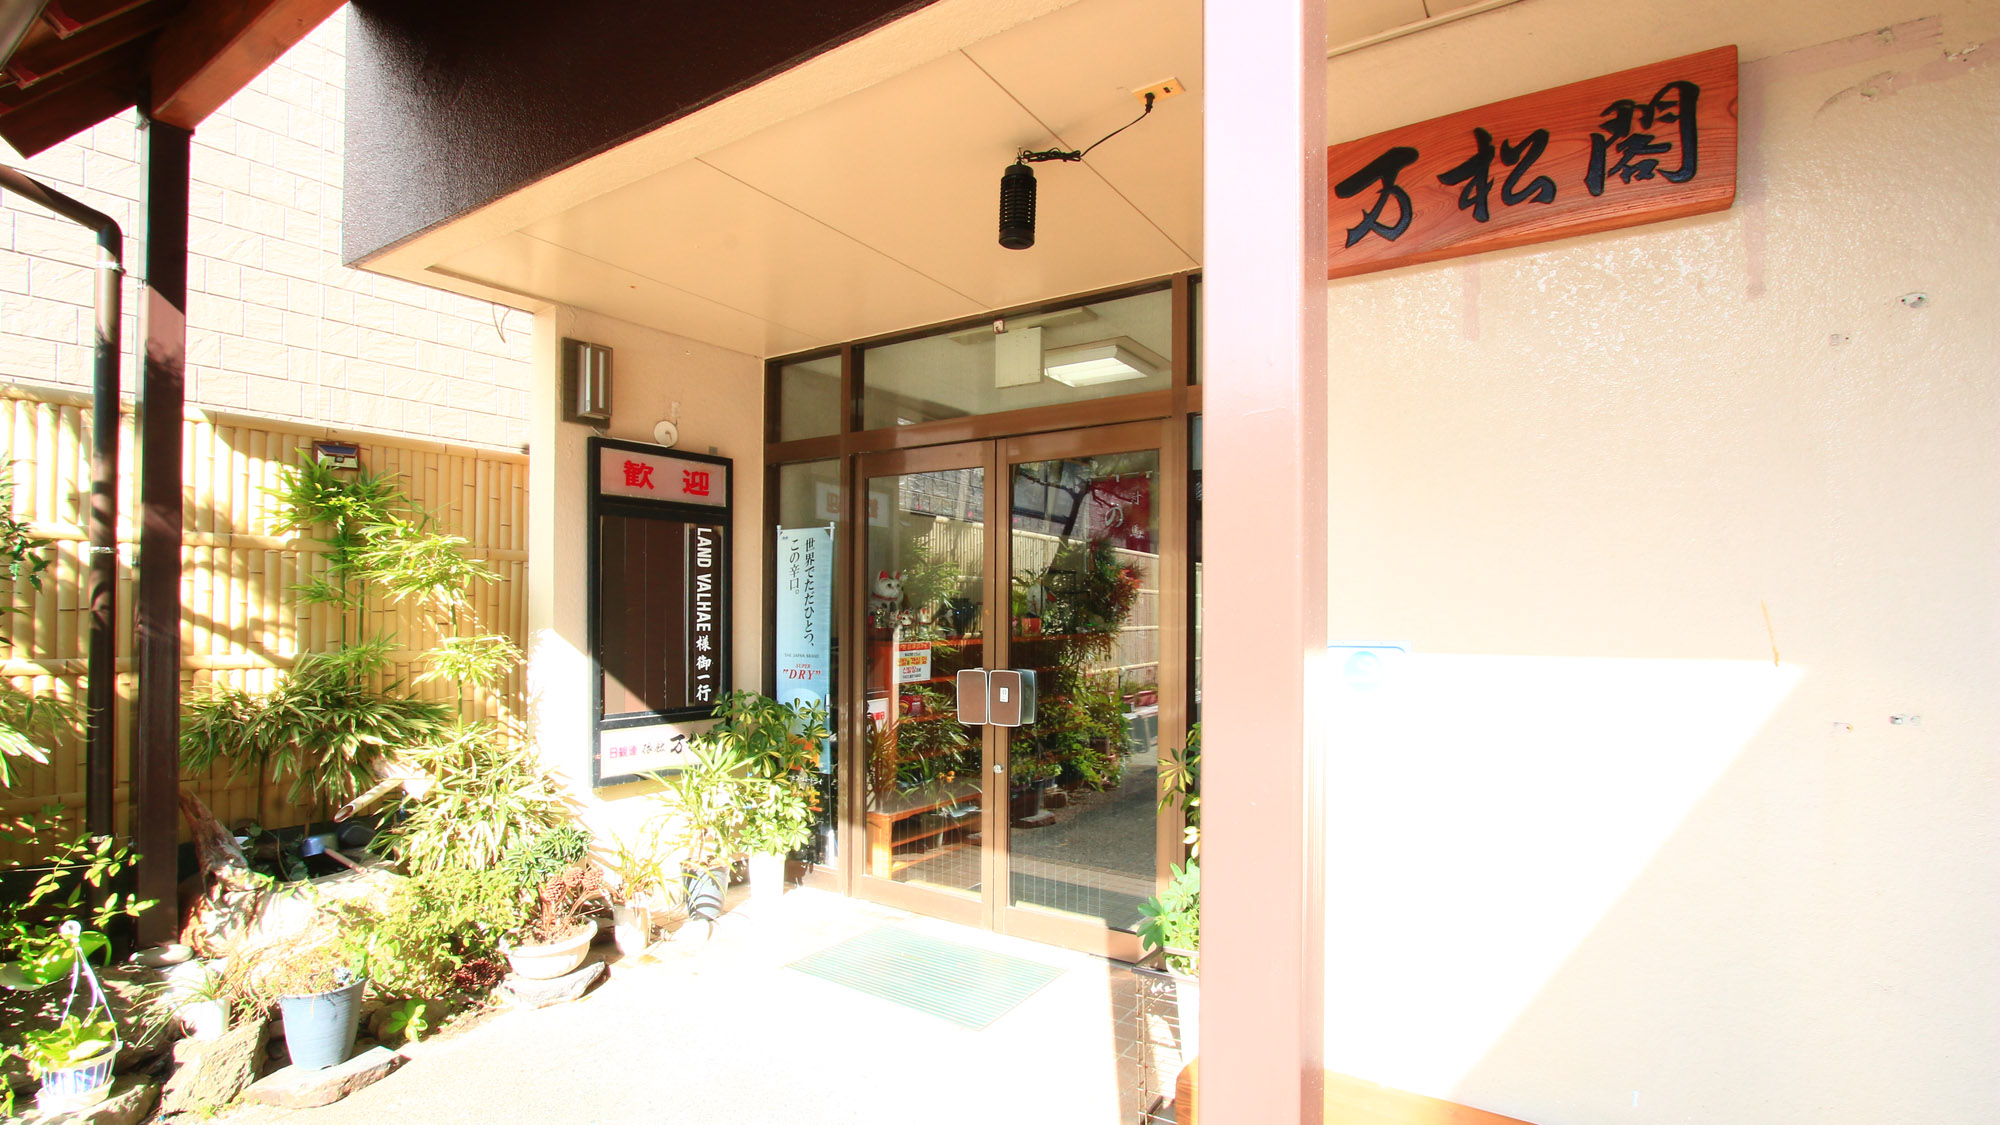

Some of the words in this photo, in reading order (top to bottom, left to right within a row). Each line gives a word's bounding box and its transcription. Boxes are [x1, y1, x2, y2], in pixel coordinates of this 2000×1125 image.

[1335, 80, 1700, 248] 万松閣
[623, 460, 710, 496] 歓迎
[697, 527, 712, 568] LAND
[789, 539, 800, 595] この辛口。
[696, 573, 712, 632] VALHAE
[804, 537, 815, 647] 世界でただひとつ、
